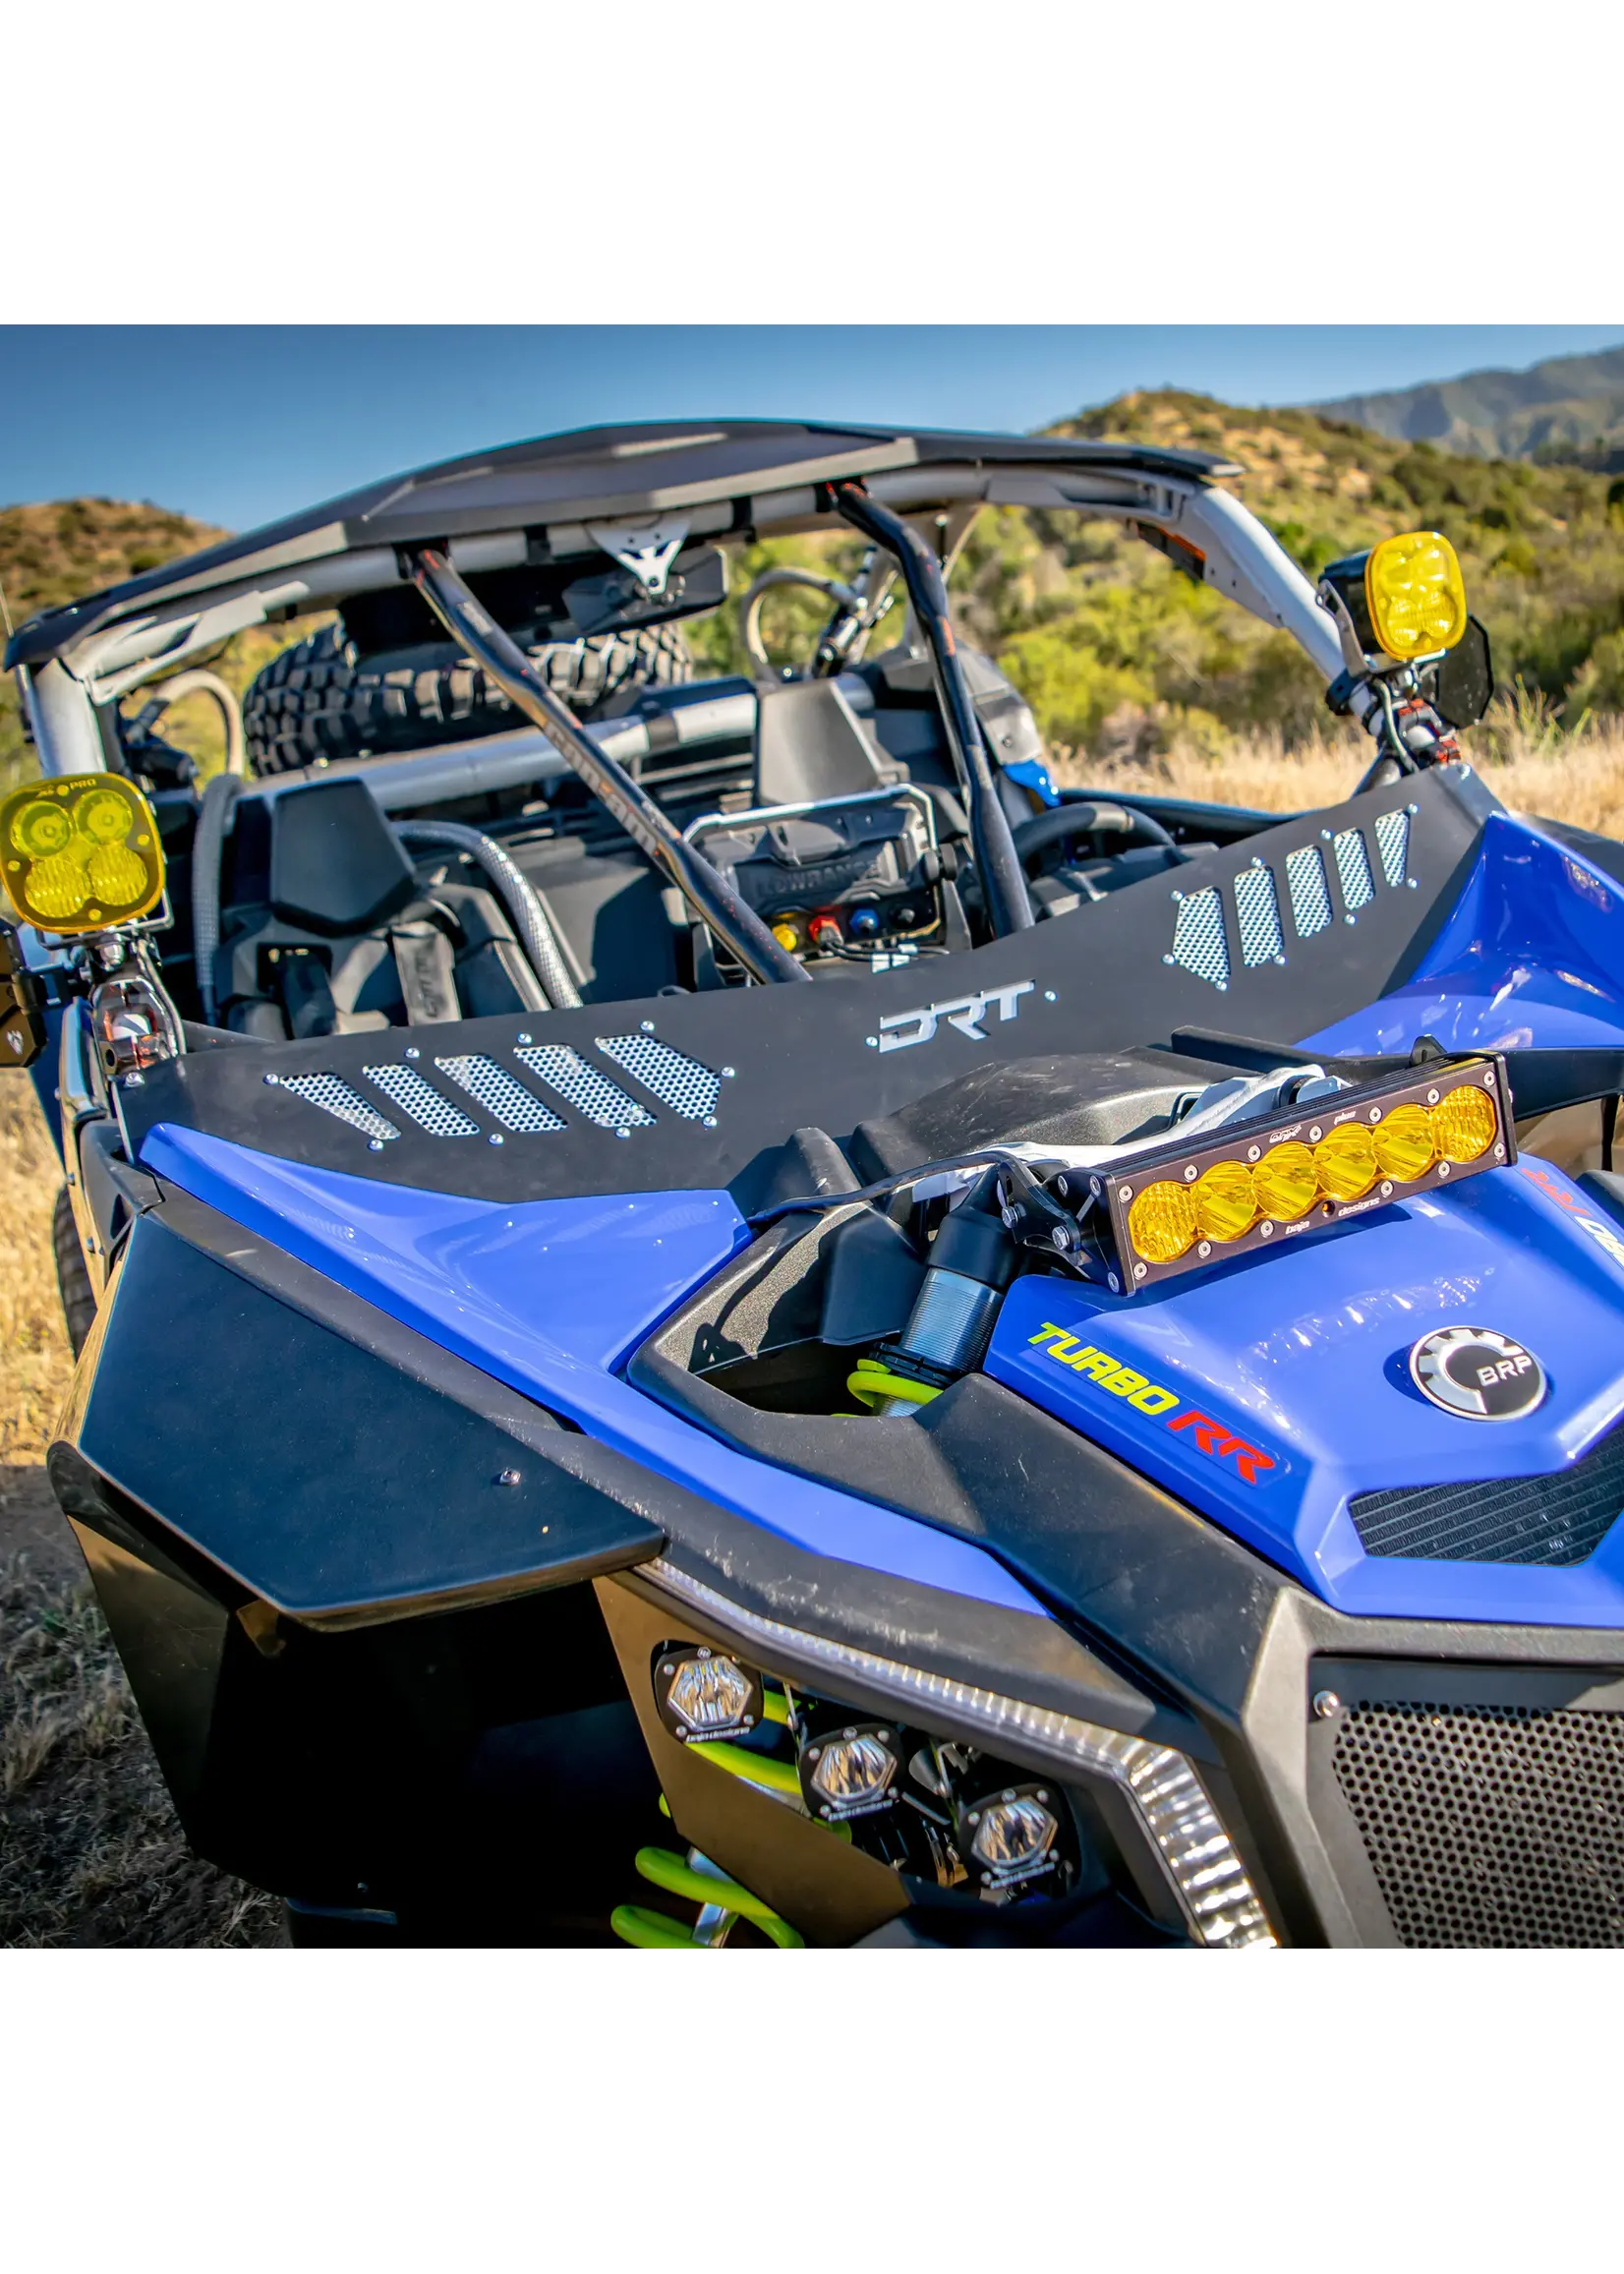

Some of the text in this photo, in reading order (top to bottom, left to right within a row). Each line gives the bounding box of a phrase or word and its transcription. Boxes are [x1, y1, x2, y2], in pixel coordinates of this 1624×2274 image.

[69, 778, 97, 790] PRO
[544, 720, 659, 853] can-am
[879, 979, 1035, 1053] DRT
[1285, 1197, 1380, 1235] baja designs
[1477, 1355, 1533, 1386] BRP
[1027, 1321, 1276, 1485] TURBO RR
